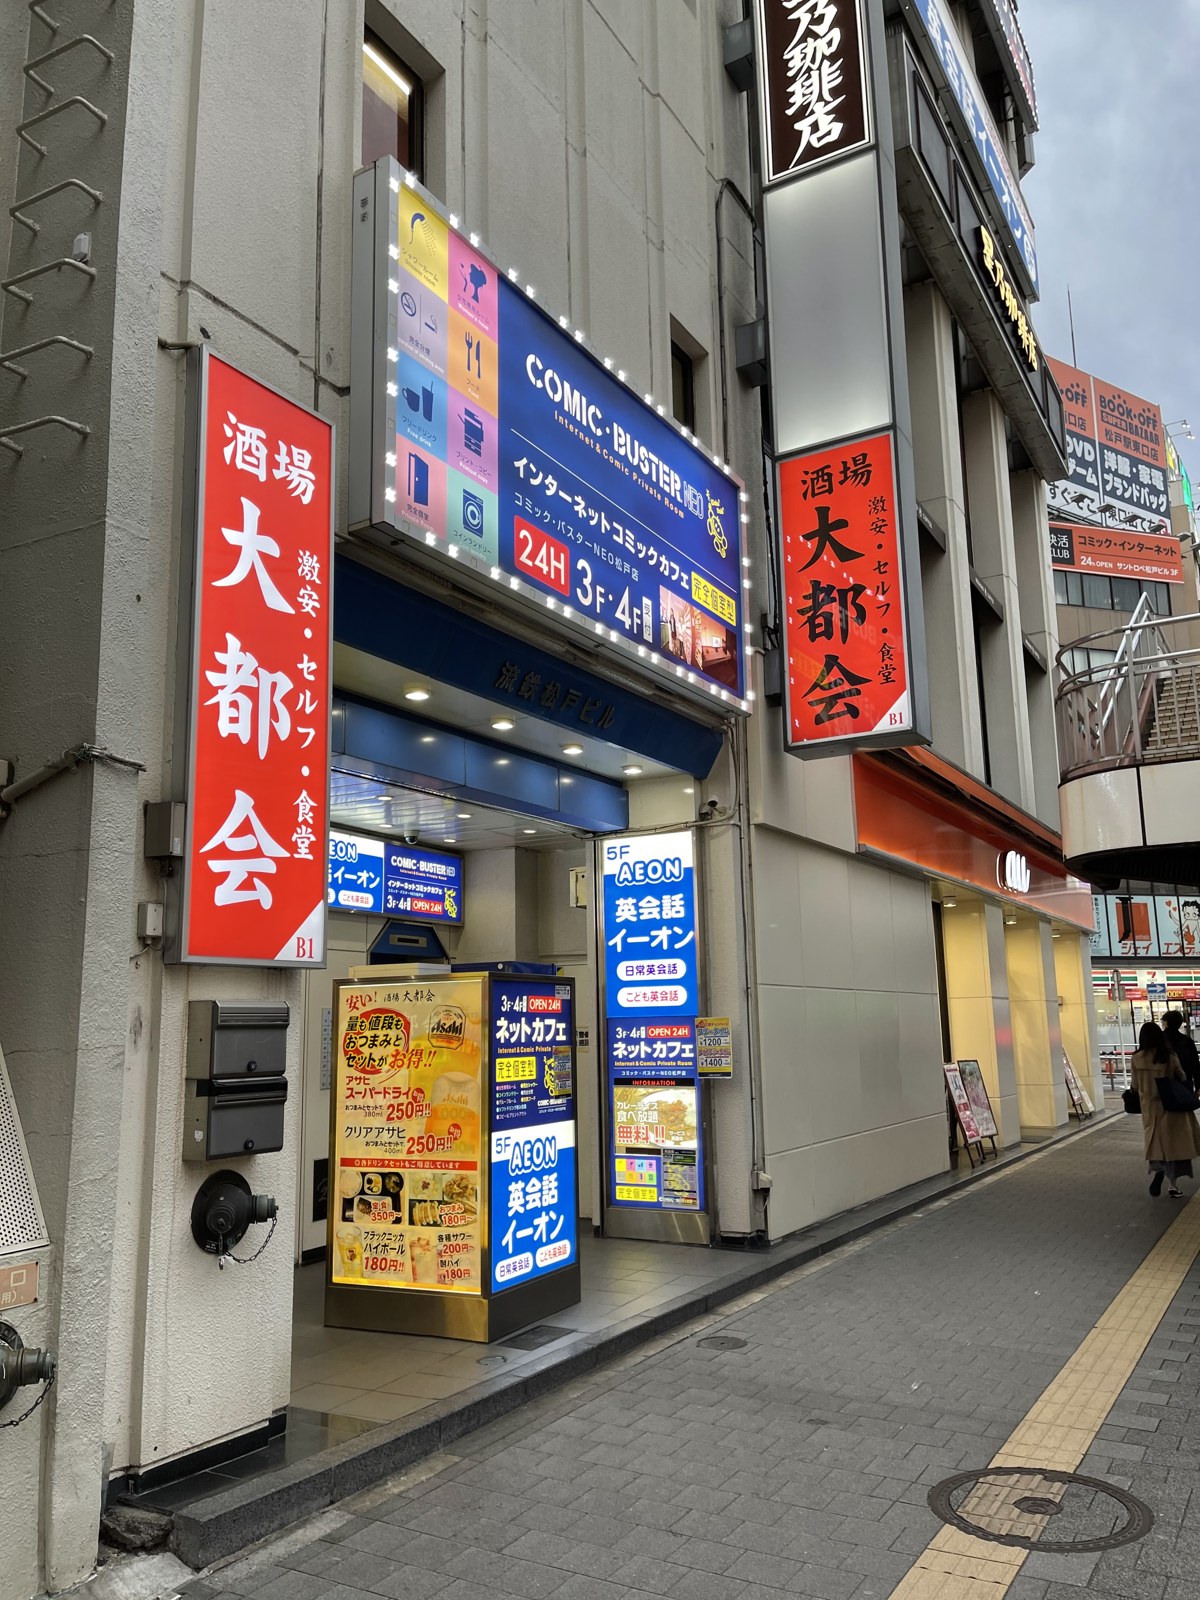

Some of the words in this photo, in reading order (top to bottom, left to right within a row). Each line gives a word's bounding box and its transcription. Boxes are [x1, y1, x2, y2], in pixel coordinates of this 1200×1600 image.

[782, 0, 846, 168] 乃珈琲店
[402, 415, 437, 442] フリードリンク
[1102, 412, 1127, 430] SUPER
[1129, 422, 1160, 446] BAZAAR
[1104, 428, 1158, 461] 松戸駅東口店
[222, 410, 316, 505] 酒場
[801, 452, 872, 500] 酒場
[1104, 449, 1164, 490] 洋服・家電
[632, 472, 661, 500] Private
[664, 498, 685, 518] Room
[1104, 473, 1167, 512] ブランドバッグ
[513, 457, 689, 590] インターネットコミックカフェ
[1078, 535, 1177, 557] コミック・インターネット
[519, 529, 565, 585] 24H
[1096, 561, 1113, 569] OPEN
[1117, 562, 1170, 576] サントロペ松戸ビル
[692, 577, 734, 622] 完全個室型
[868, 496, 896, 685] 激安・セルフ・食堂
[796, 505, 873, 726] 大都会
[199, 496, 296, 910] 大都会
[292, 549, 322, 861] 激安・セルフ・食堂
[889, 712, 904, 725] B1
[329, 839, 357, 862] EON
[607, 844, 630, 860] 5F
[616, 857, 683, 886] AEON
[387, 880, 443, 895] インターネットコミックカフェ
[342, 892, 369, 905] こども英会話
[413, 901, 429, 911] OPEN
[430, 903, 442, 912] 24H
[615, 893, 685, 922] 英会話
[295, 936, 314, 959] B1
[608, 926, 694, 952] イーオン
[1121, 942, 1153, 955] ジェイ
[625, 963, 678, 976] 日常英会話
[403, 989, 435, 1002] 大都会
[529, 999, 547, 1011] OPEN
[548, 998, 561, 1011] 24H
[626, 990, 679, 1002] こども英会話
[345, 1015, 403, 1031] 量も値段も
[431, 1019, 463, 1035] Asahi
[496, 1017, 567, 1043] ネットカフェ
[648, 1028, 670, 1036] OPEN
[672, 1027, 688, 1036] 24H
[345, 1034, 403, 1049] おつまみと
[613, 1041, 695, 1059] ネットカフェ
[497, 1060, 535, 1079] 完全個室型
[346, 1076, 370, 1086] アサヒ
[345, 1087, 412, 1100] スーパードライ
[617, 1101, 658, 1110] カレーライス
[617, 1110, 659, 1122] 食べ放題
[344, 1126, 406, 1139] クリアアサヒ
[495, 1136, 511, 1154] 5F
[510, 1136, 558, 1175] AEON
[508, 1172, 558, 1217] 英会話
[618, 1188, 656, 1199] 完全個室型
[372, 1201, 387, 1209] 定食
[440, 1204, 463, 1213] おつまみ
[364, 1231, 405, 1241] ブラックニッカ
[437, 1233, 473, 1242] 各種サワー
[502, 1210, 564, 1254] イーオン
[363, 1243, 405, 1255] ハイボール
[540, 1243, 568, 1262] こども英会話
[440, 1259, 461, 1268] 酎ハイ
[500, 1256, 530, 1277] 日常英会話
[445, 1269, 471, 1279] 180円
